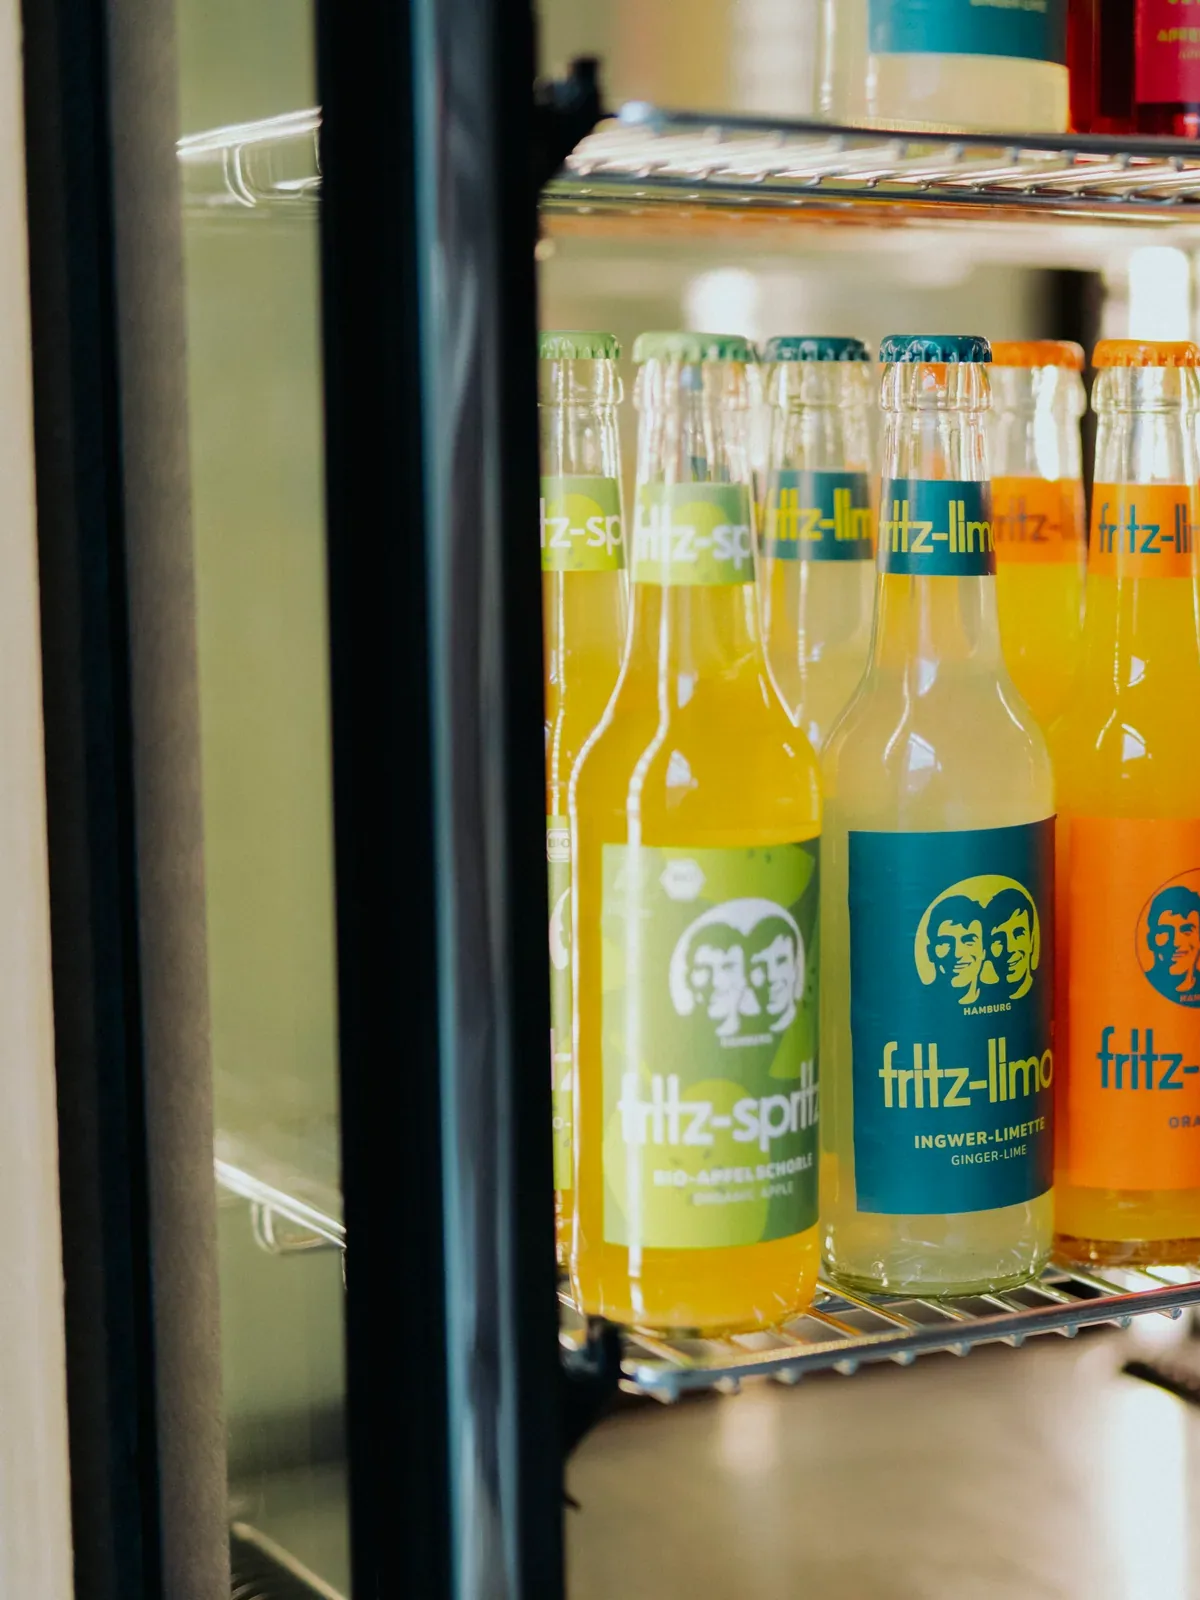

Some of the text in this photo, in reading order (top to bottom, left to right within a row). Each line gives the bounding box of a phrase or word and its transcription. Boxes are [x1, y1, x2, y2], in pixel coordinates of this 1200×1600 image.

[963, 1002, 1012, 1016] HAMBURG
[878, 1036, 1053, 1109] fritz-limo
[914, 1116, 1045, 1149] INGWER-LIMETTE
[951, 1144, 1027, 1166] GINGER-LIME
